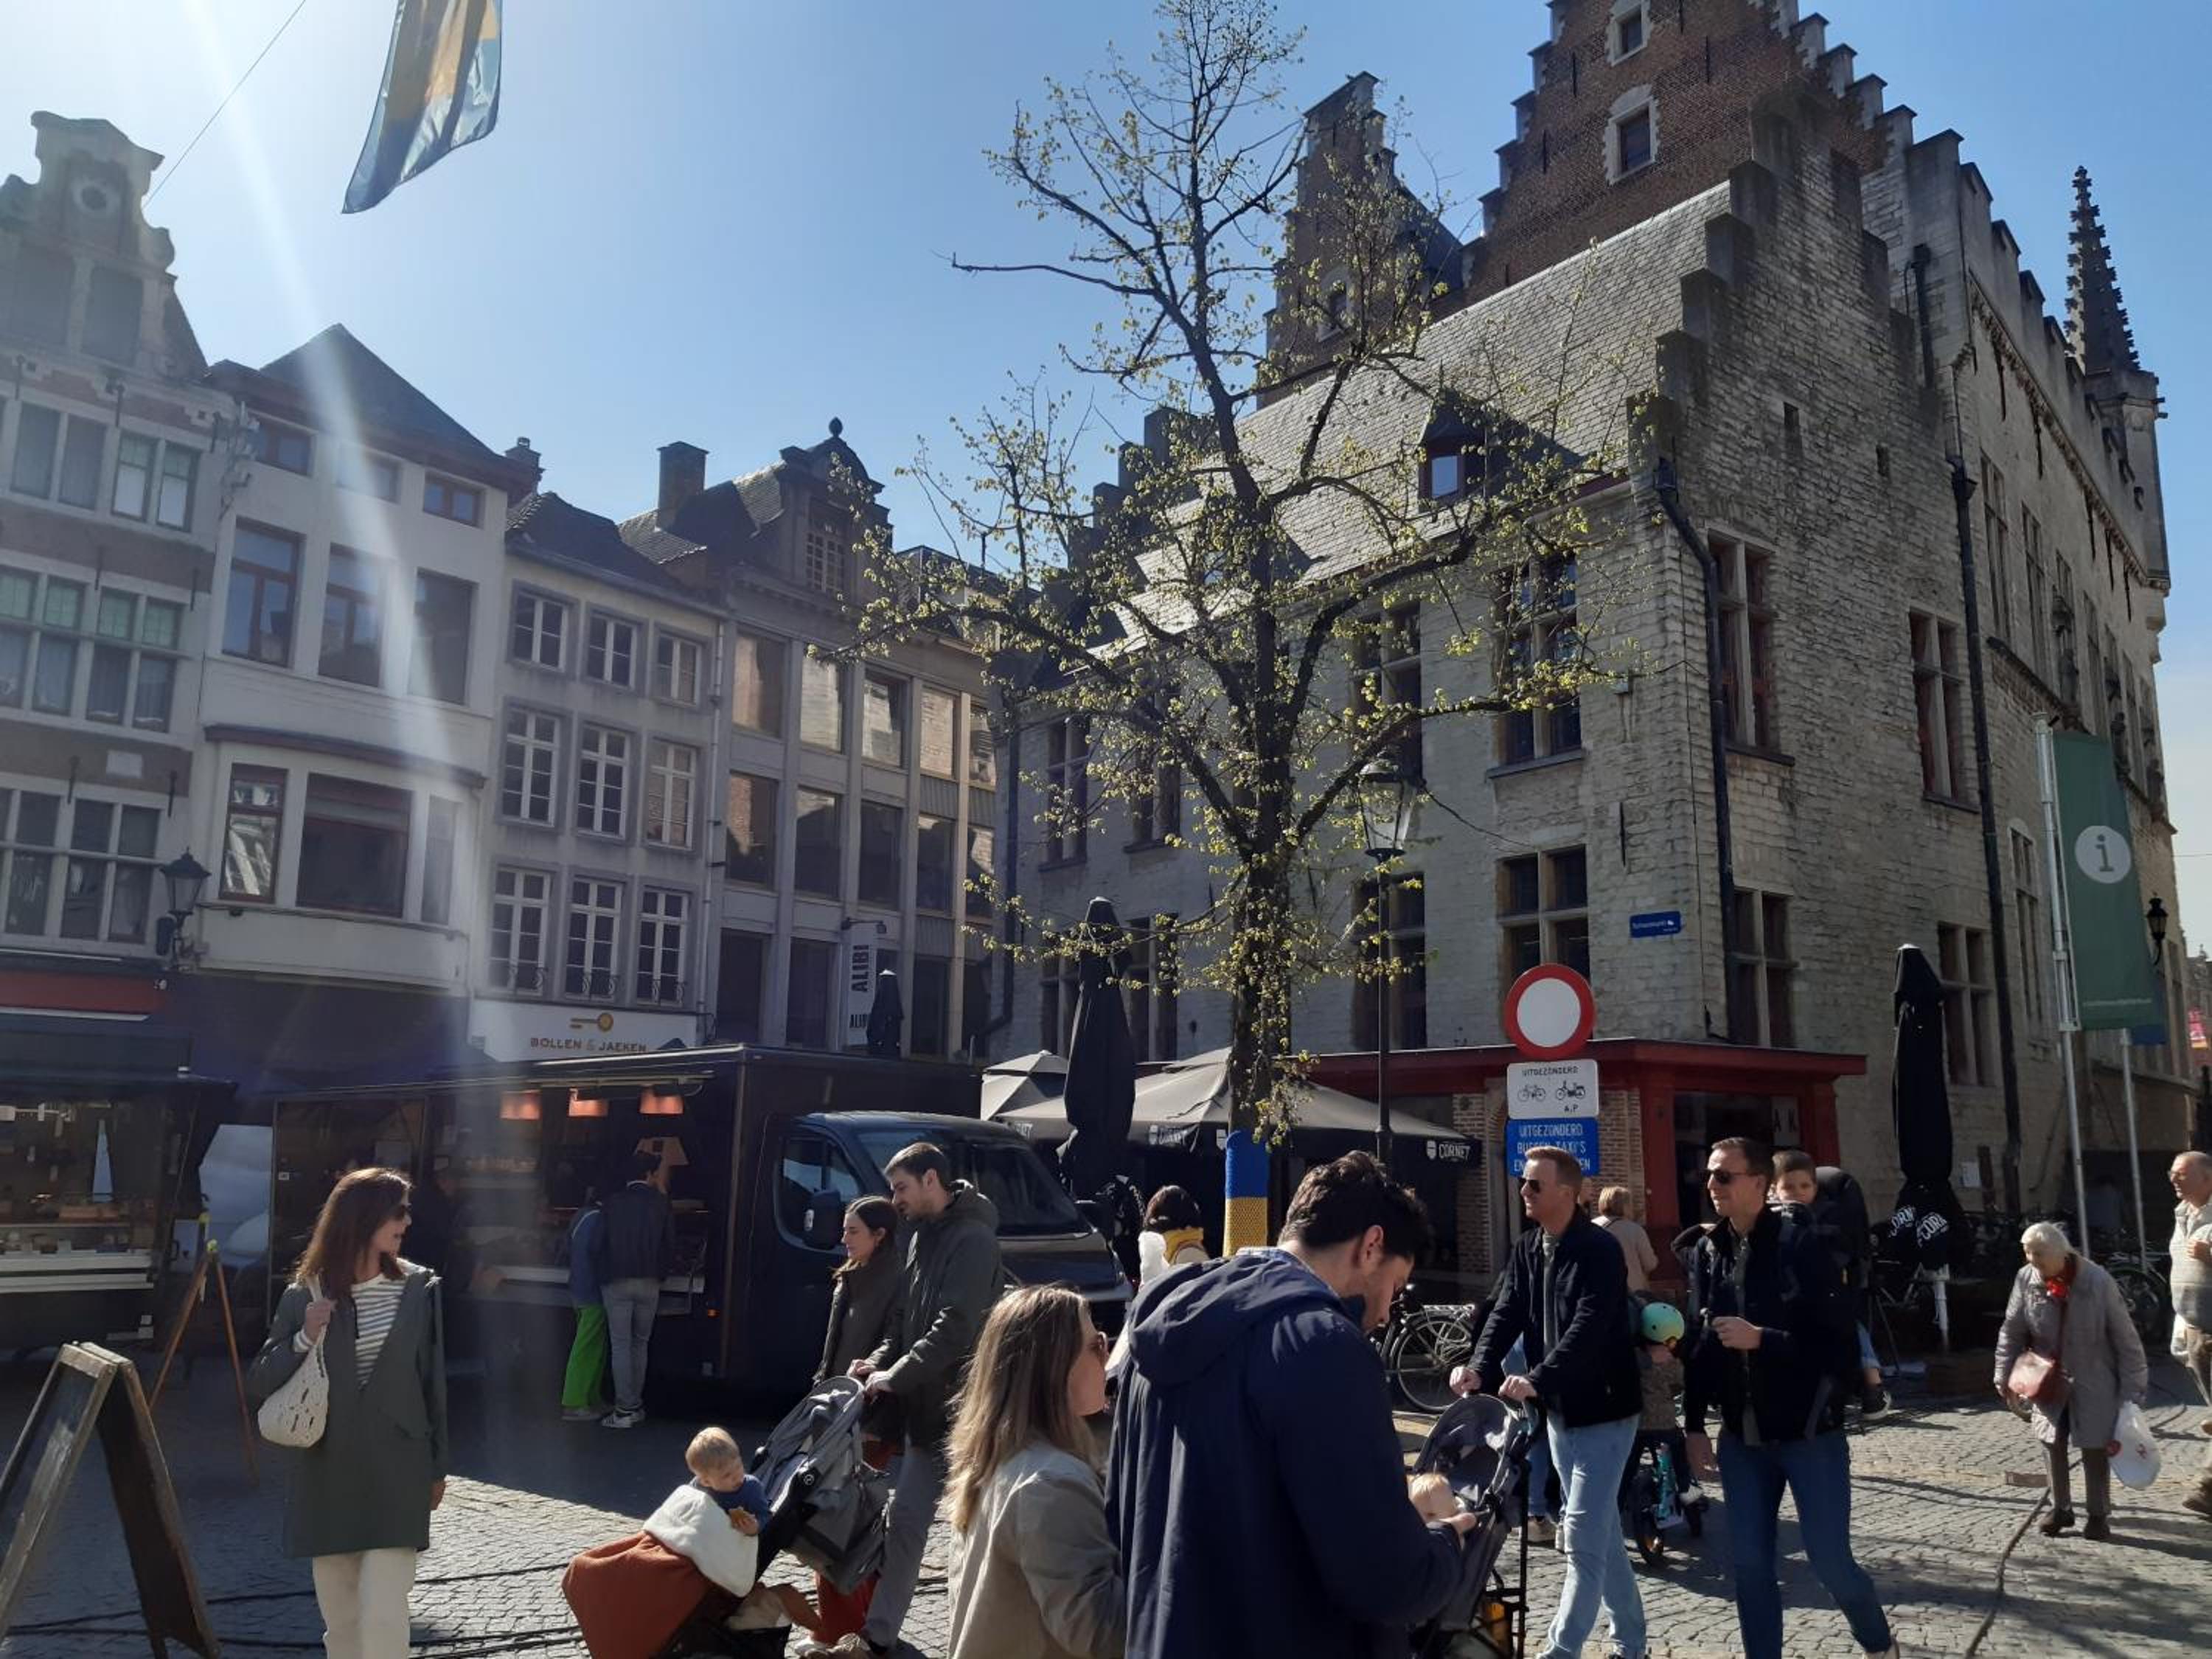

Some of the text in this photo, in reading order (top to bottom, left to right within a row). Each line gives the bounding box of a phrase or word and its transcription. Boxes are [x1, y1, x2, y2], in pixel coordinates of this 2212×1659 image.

[852, 945, 869, 992] ALIBI
[530, 1037, 582, 1050] BOLLEN
[599, 1041, 647, 1053] JAEKEN
[1522, 1065, 1579, 1077] UITGEZONDERD
[1519, 1123, 1583, 1138] UITGEZONDERD
[1439, 1144, 1471, 1160] CORNET
